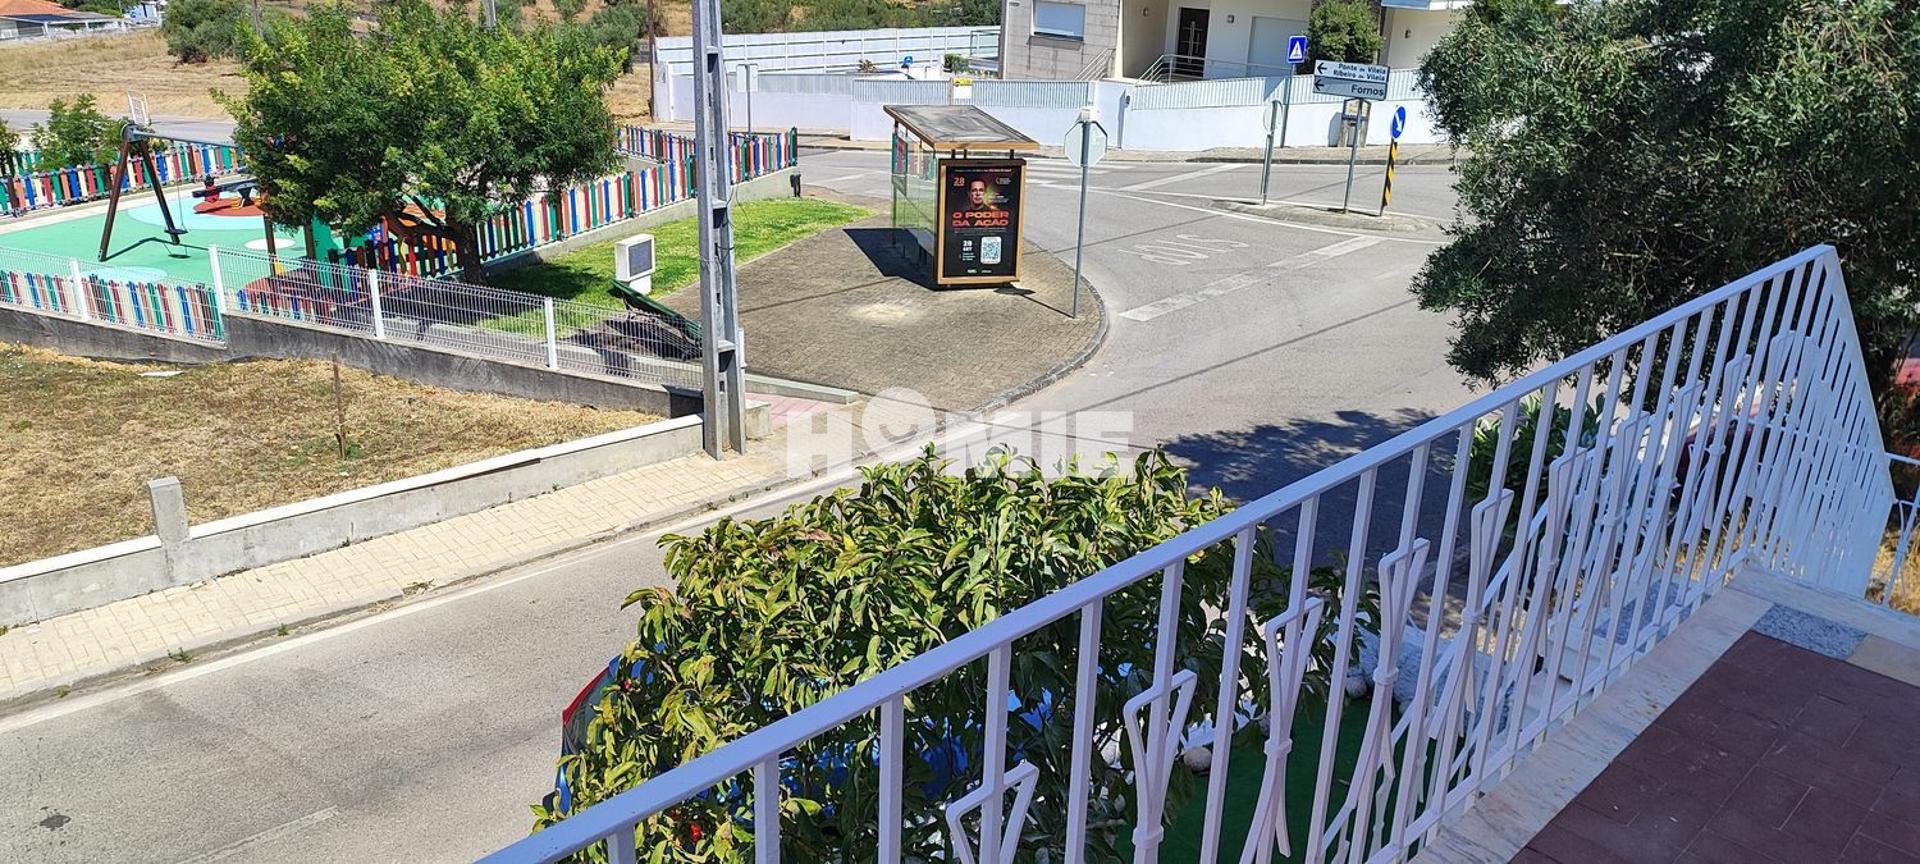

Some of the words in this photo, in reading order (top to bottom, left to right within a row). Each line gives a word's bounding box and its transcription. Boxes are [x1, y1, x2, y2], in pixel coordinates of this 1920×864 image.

[1338, 63, 1357, 71] Ponte
[1351, 84, 1384, 96] Fornos
[974, 218, 1009, 227] AÇÃO
